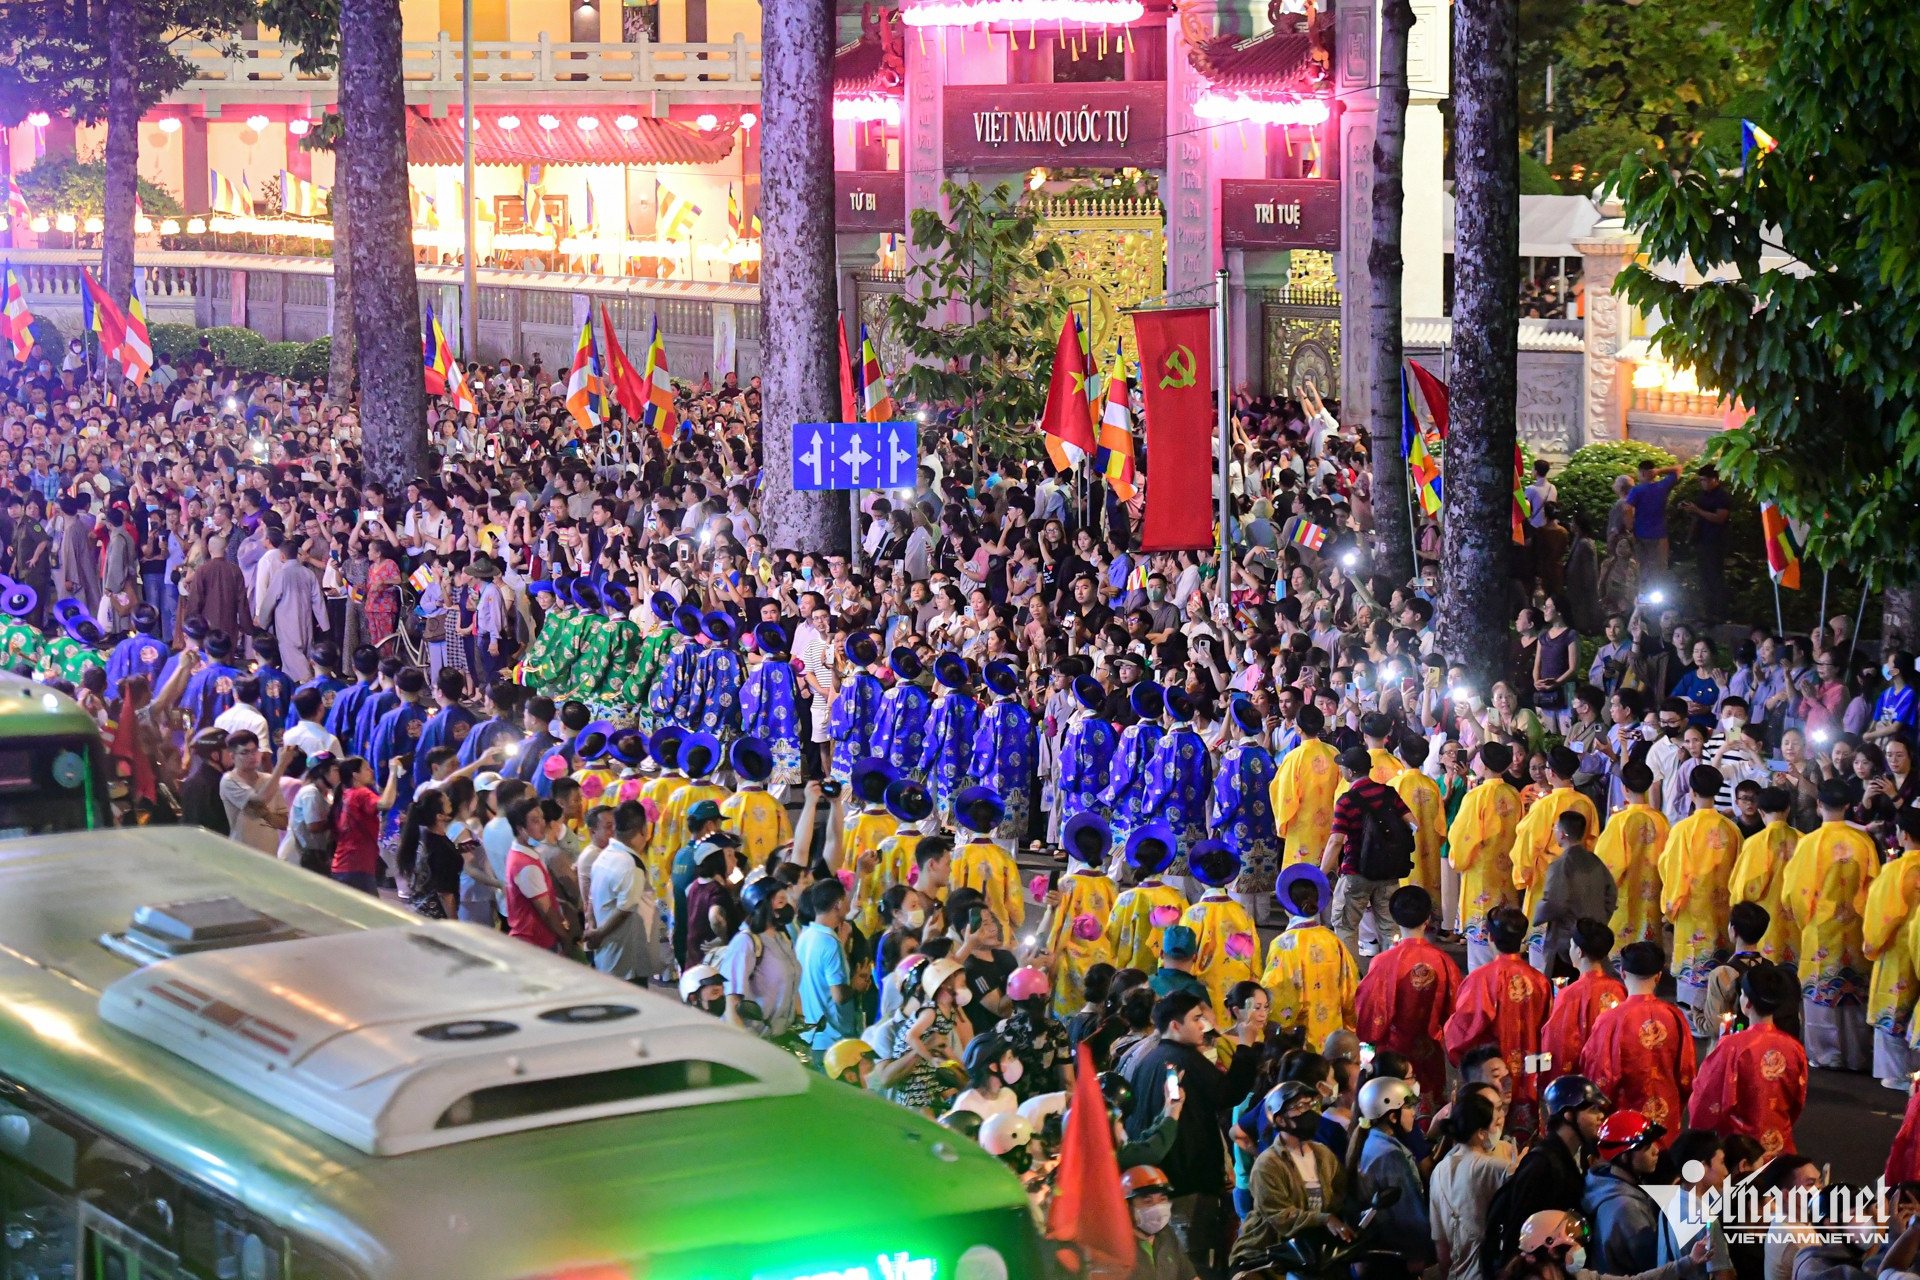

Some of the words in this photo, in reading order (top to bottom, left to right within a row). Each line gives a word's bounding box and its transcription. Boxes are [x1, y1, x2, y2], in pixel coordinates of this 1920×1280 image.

[973, 106, 1012, 147] VIỆT
[1014, 111, 1051, 142] NAM
[1054, 104, 1101, 147] QUỐC
[1104, 105, 1130, 147] TỰ
[865, 193, 877, 211] BI
[1254, 197, 1275, 224] TRÍ
[1276, 198, 1301, 230] TUỆ
